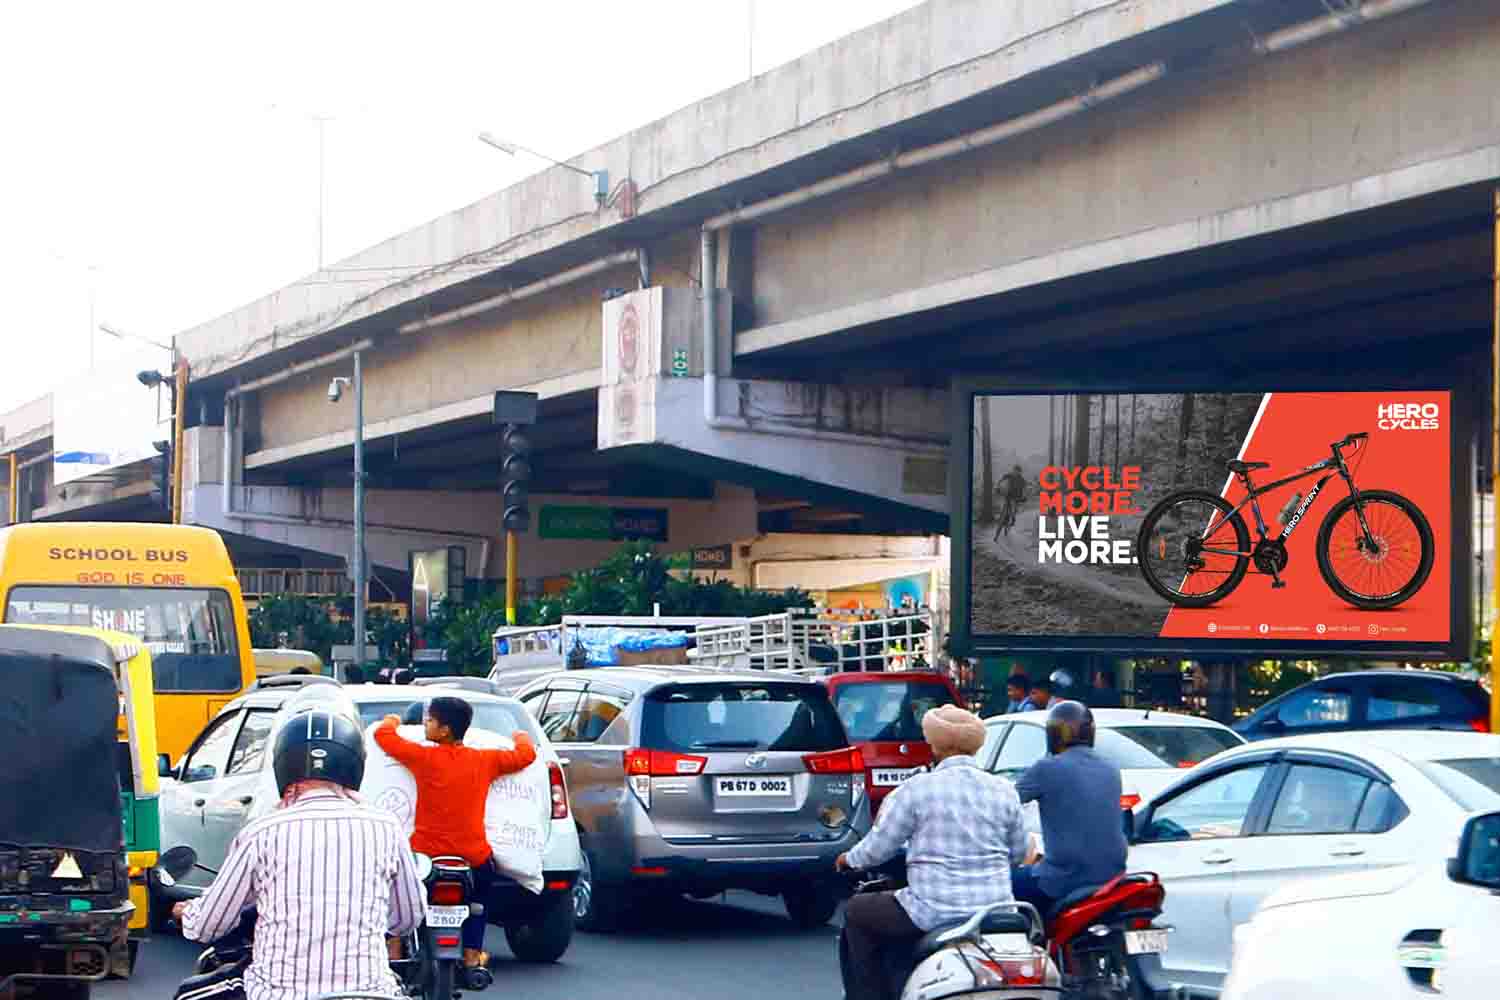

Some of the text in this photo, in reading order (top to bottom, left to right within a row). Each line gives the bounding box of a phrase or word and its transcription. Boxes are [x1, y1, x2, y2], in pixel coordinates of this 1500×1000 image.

[1377, 403, 1439, 418] HERO
[1377, 419, 1440, 430] CYCLES
[1040, 465, 1141, 490] CYCLE
[1039, 515, 1109, 539] LIVE
[49, 548, 189, 562] SCHOOL BUS
[1038, 540, 1139, 564] MORE.
[77, 572, 185, 585] GOD IS ONE
[760, 780, 787, 791] 0002
